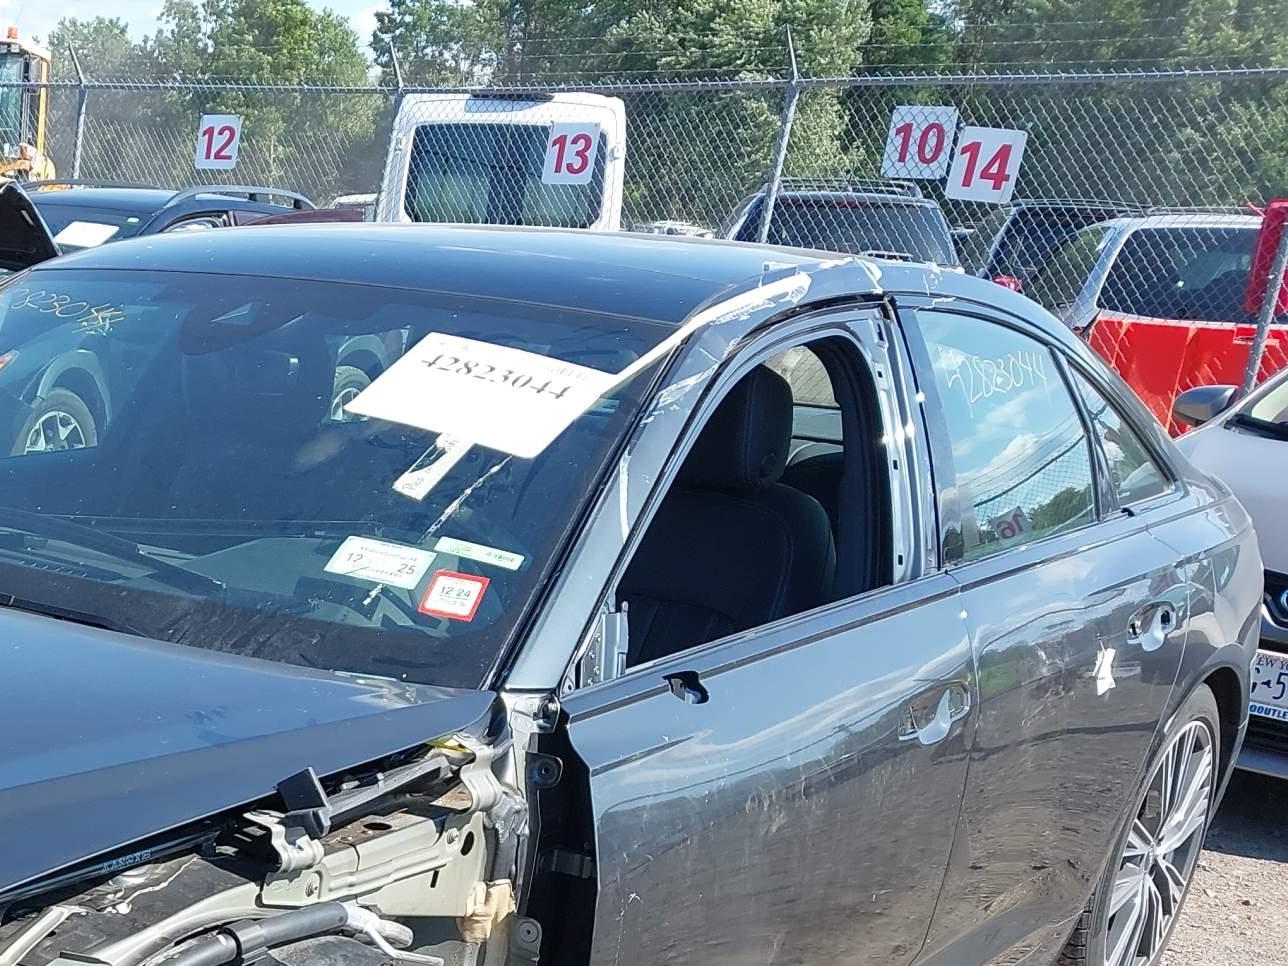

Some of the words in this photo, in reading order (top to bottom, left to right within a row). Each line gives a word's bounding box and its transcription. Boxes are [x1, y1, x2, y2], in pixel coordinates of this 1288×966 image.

[202, 125, 236, 160] 12
[551, 133, 593, 175] 13
[895, 122, 946, 165] 10
[960, 141, 1013, 191] 14
[421, 353, 572, 400] 42823044
[397, 563, 417, 575] 25
[440, 585, 455, 596] 12
[456, 589, 472, 599] 24
[1256, 657, 1277, 668] EW
